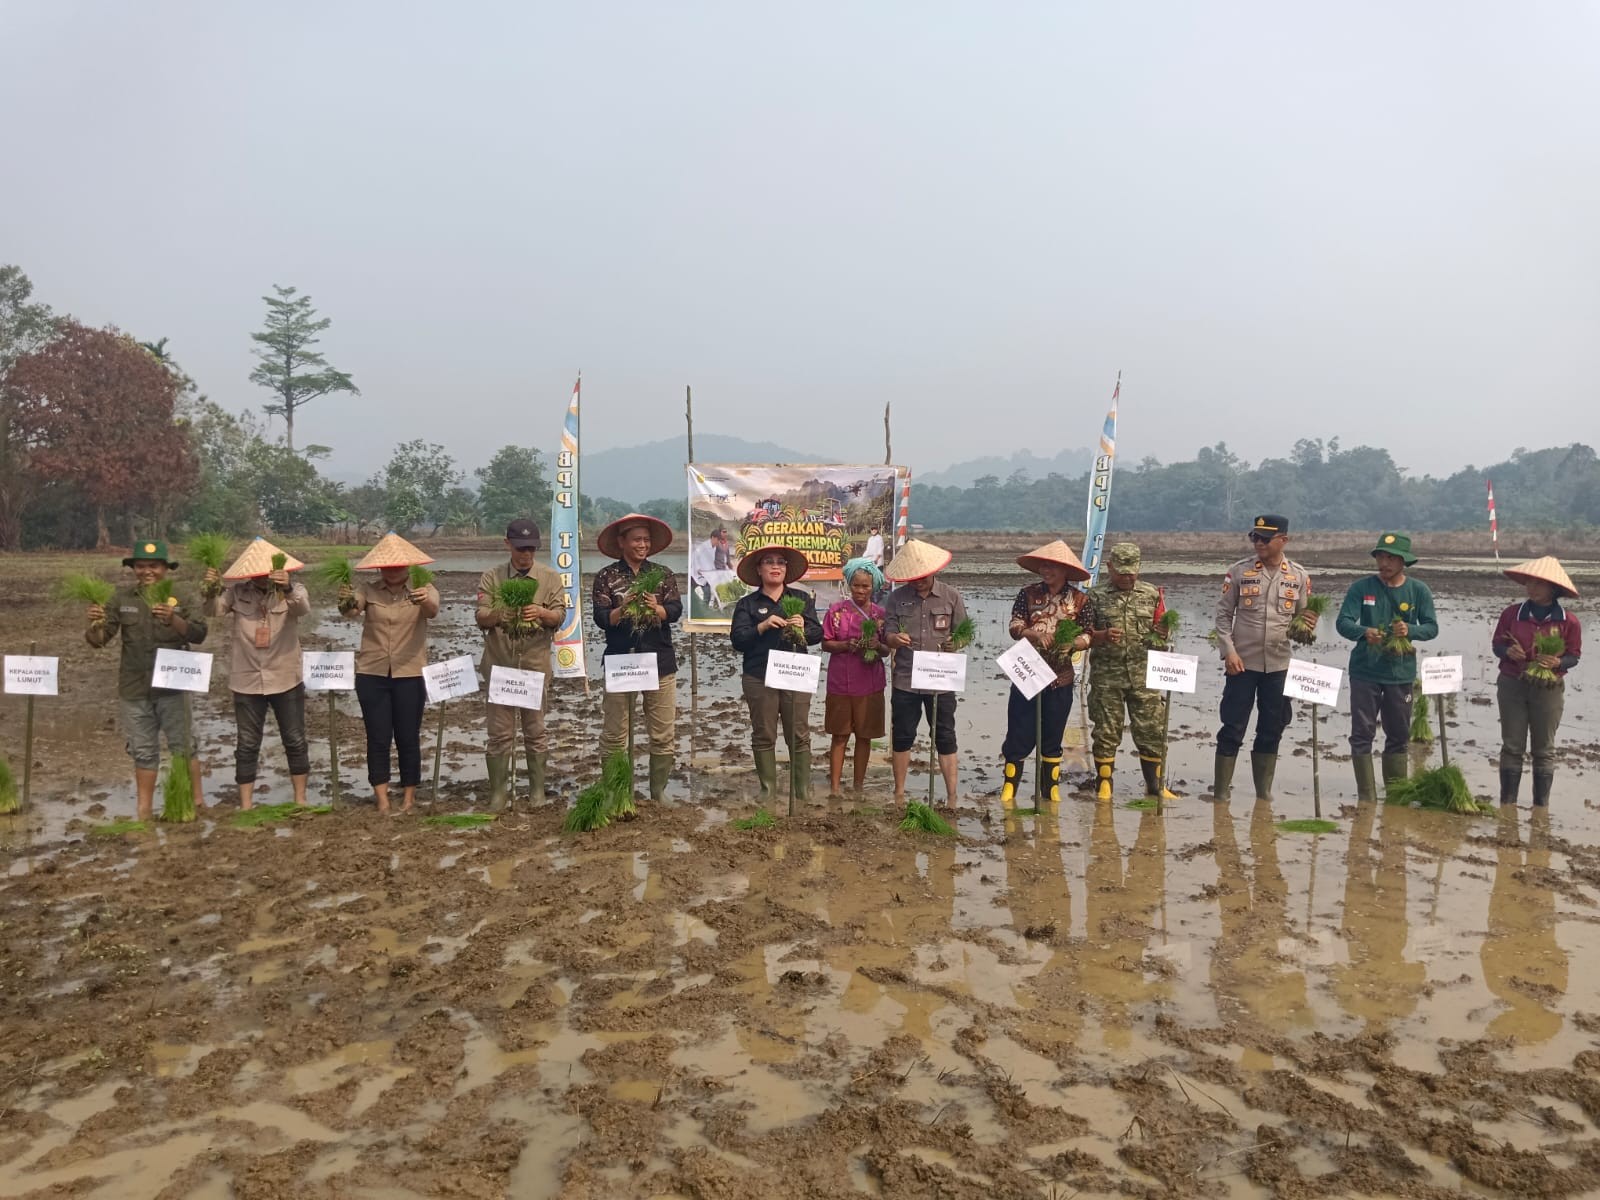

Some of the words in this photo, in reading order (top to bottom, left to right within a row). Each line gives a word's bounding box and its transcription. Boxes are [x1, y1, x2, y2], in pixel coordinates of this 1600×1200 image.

[763, 522, 825, 535] GERAKAN
[748, 535, 785, 550] TANAM
[785, 535, 841, 551] SEREMPAK
[1012, 664, 1027, 682] TOBA
[1017, 656, 1036, 678] CAMAT
[1151, 665, 1188, 676] DANRAMIL
[1159, 675, 1178, 683] TOBA
[1292, 674, 1332, 689] KAPOLSEK
[1300, 684, 1320, 695] TOBA
